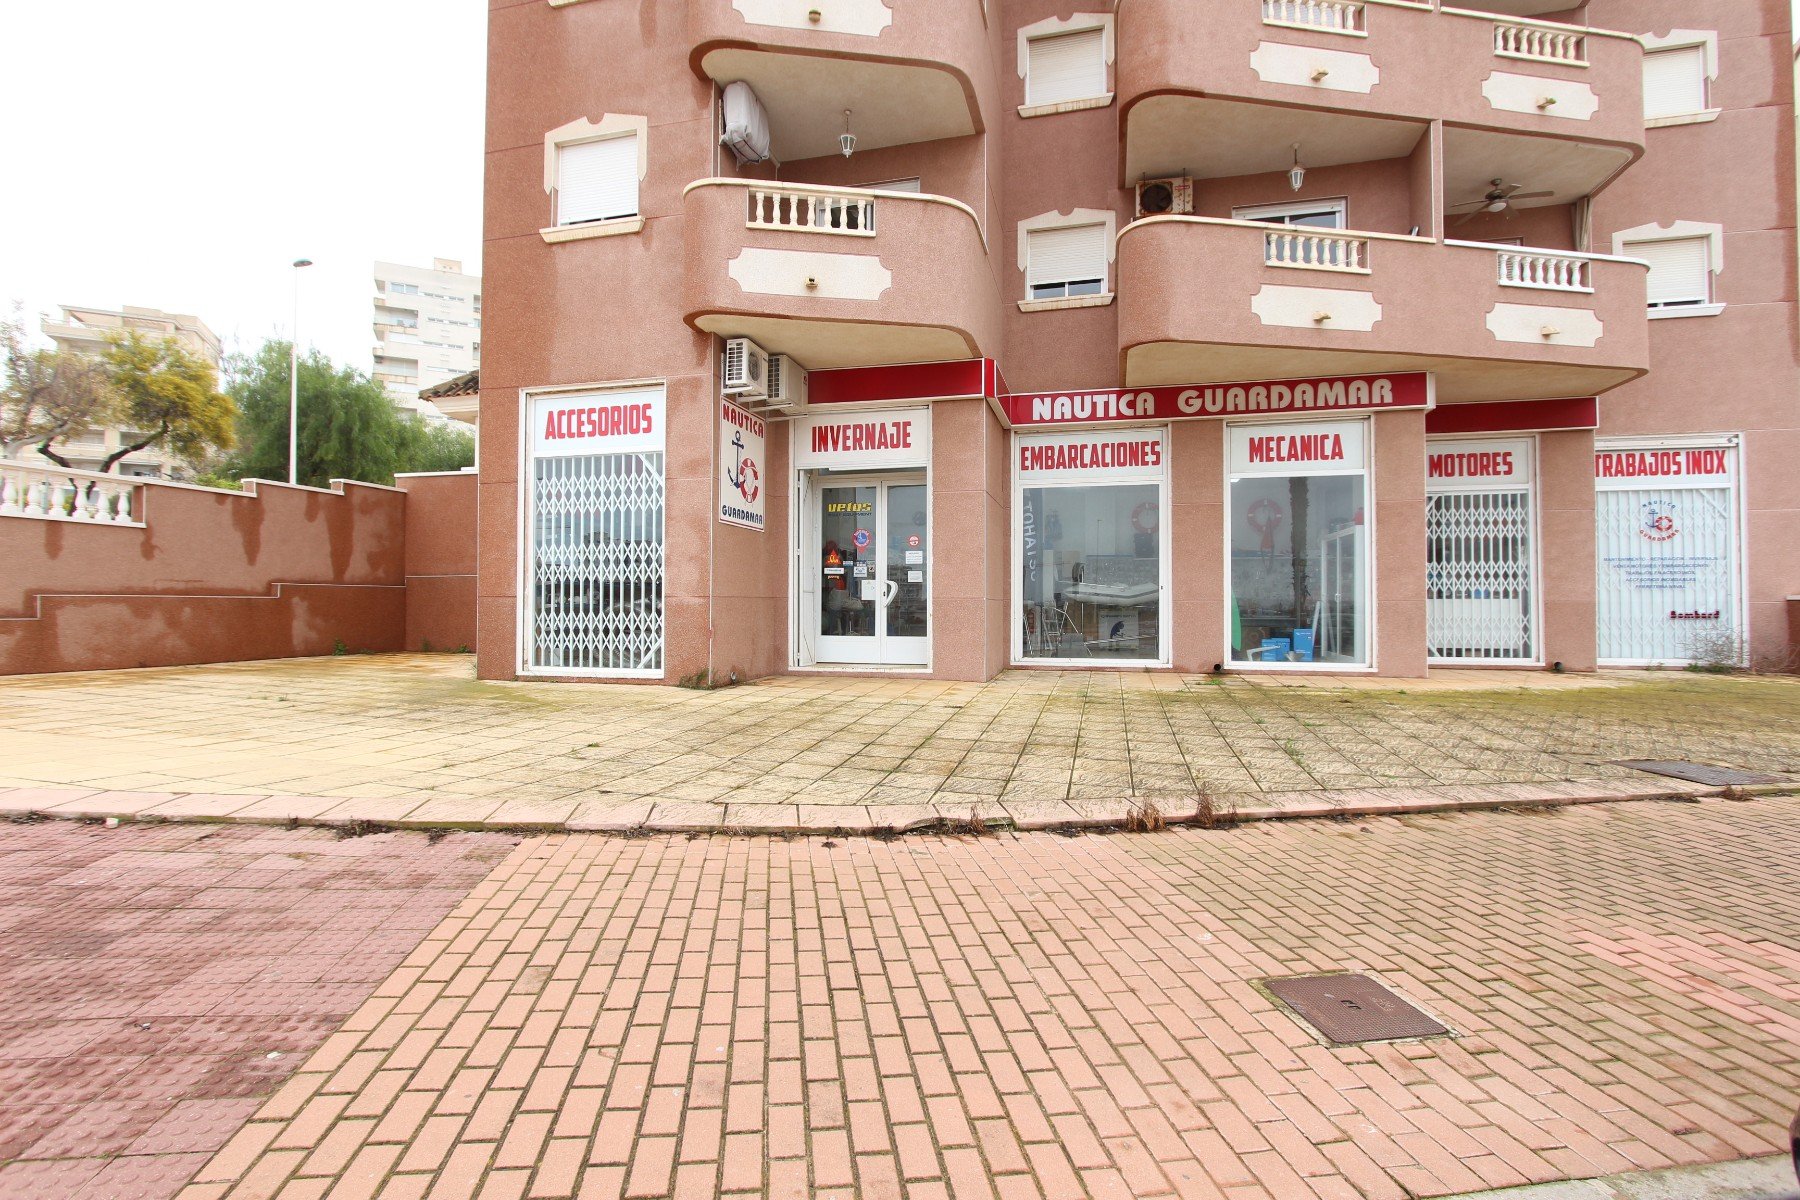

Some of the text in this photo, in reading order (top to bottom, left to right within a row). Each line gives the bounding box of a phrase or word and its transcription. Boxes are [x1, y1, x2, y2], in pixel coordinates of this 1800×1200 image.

[1032, 378, 1393, 421] NAUTICA GUARDAMAR
[544, 403, 652, 440] ACCESORIOS
[722, 403, 764, 439] NAUTICA
[811, 421, 912, 453] INVERNAJE
[1248, 433, 1344, 463] MECANICA
[1020, 440, 1161, 471] EMBARCACIONES
[1428, 451, 1513, 478] MOTORES
[1595, 450, 1727, 477] TRABAJOS INOX
[722, 504, 763, 525] GUARDAMAR
